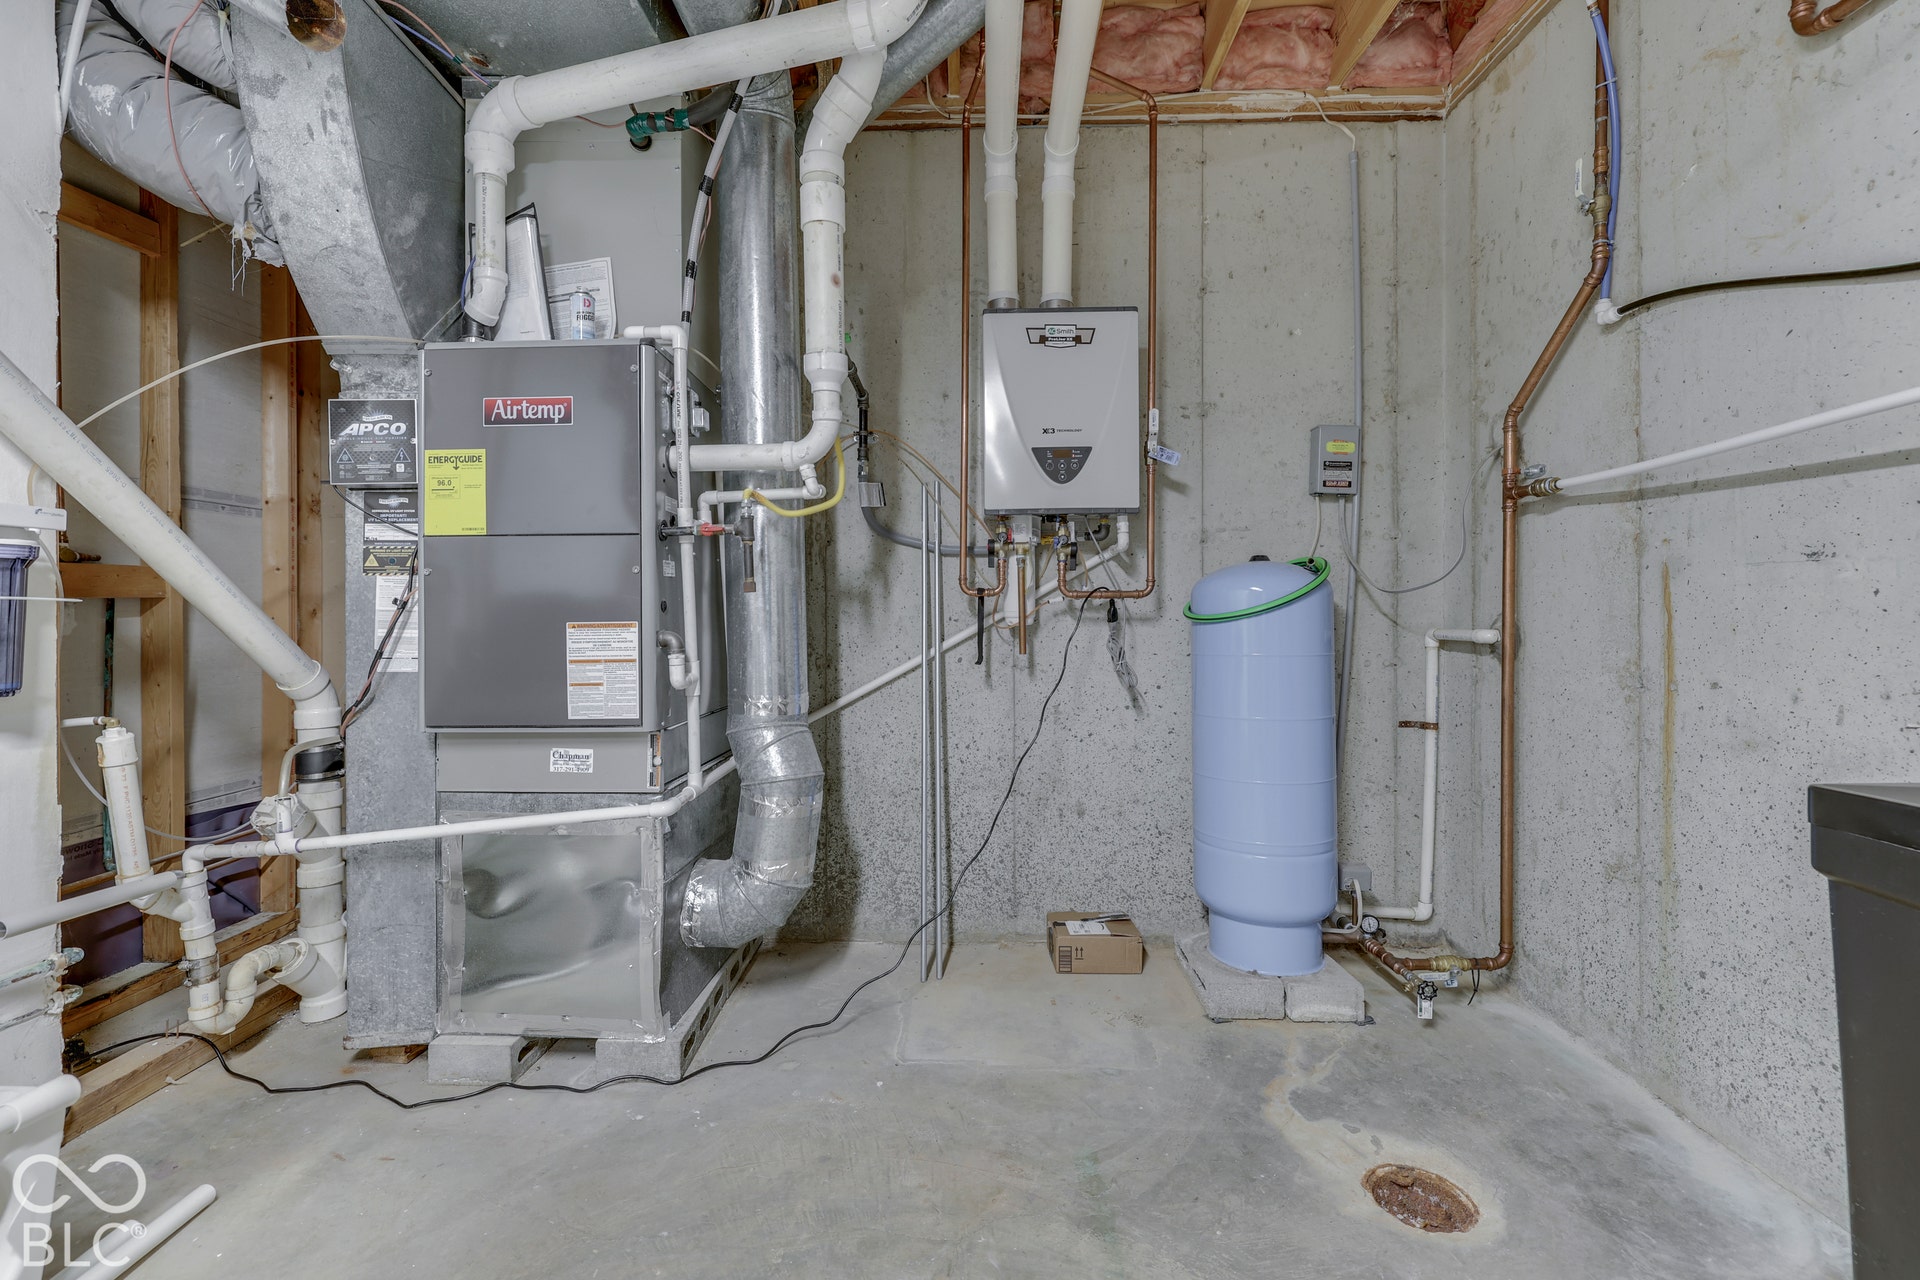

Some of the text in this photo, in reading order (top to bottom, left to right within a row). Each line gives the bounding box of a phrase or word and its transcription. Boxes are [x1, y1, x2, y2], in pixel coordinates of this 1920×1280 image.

[492, 400, 566, 423] Airtemp
[339, 422, 407, 436] APCO
[428, 455, 483, 464] ENERGYGUIDE
[553, 750, 590, 761] Chapman
